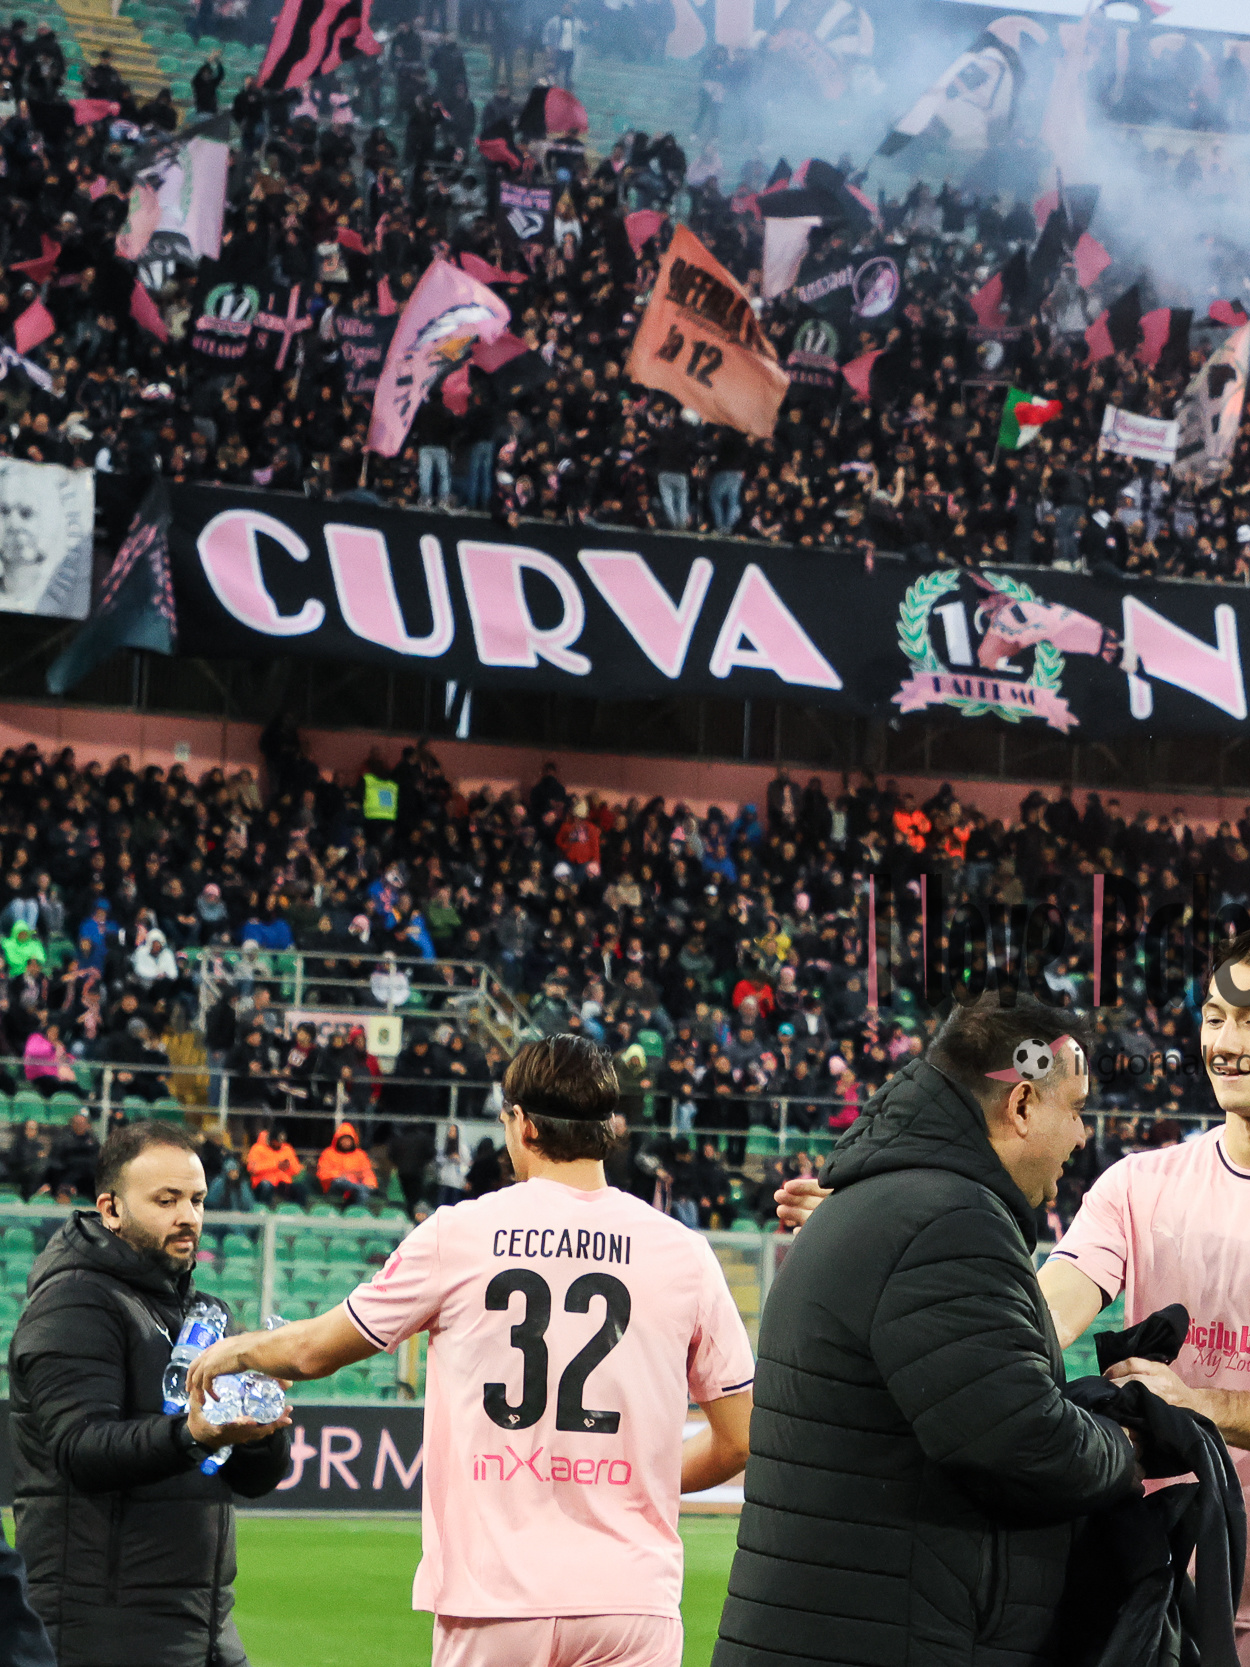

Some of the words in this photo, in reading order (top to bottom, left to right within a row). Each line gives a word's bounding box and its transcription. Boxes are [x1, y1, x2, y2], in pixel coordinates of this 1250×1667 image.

[198, 510, 844, 691] CURVA
[493, 1229, 631, 1264] CECCARONI
[483, 1268, 631, 1434] 32
[1193, 1346, 1222, 1378] My
[473, 1446, 632, 1485] inX.aero
